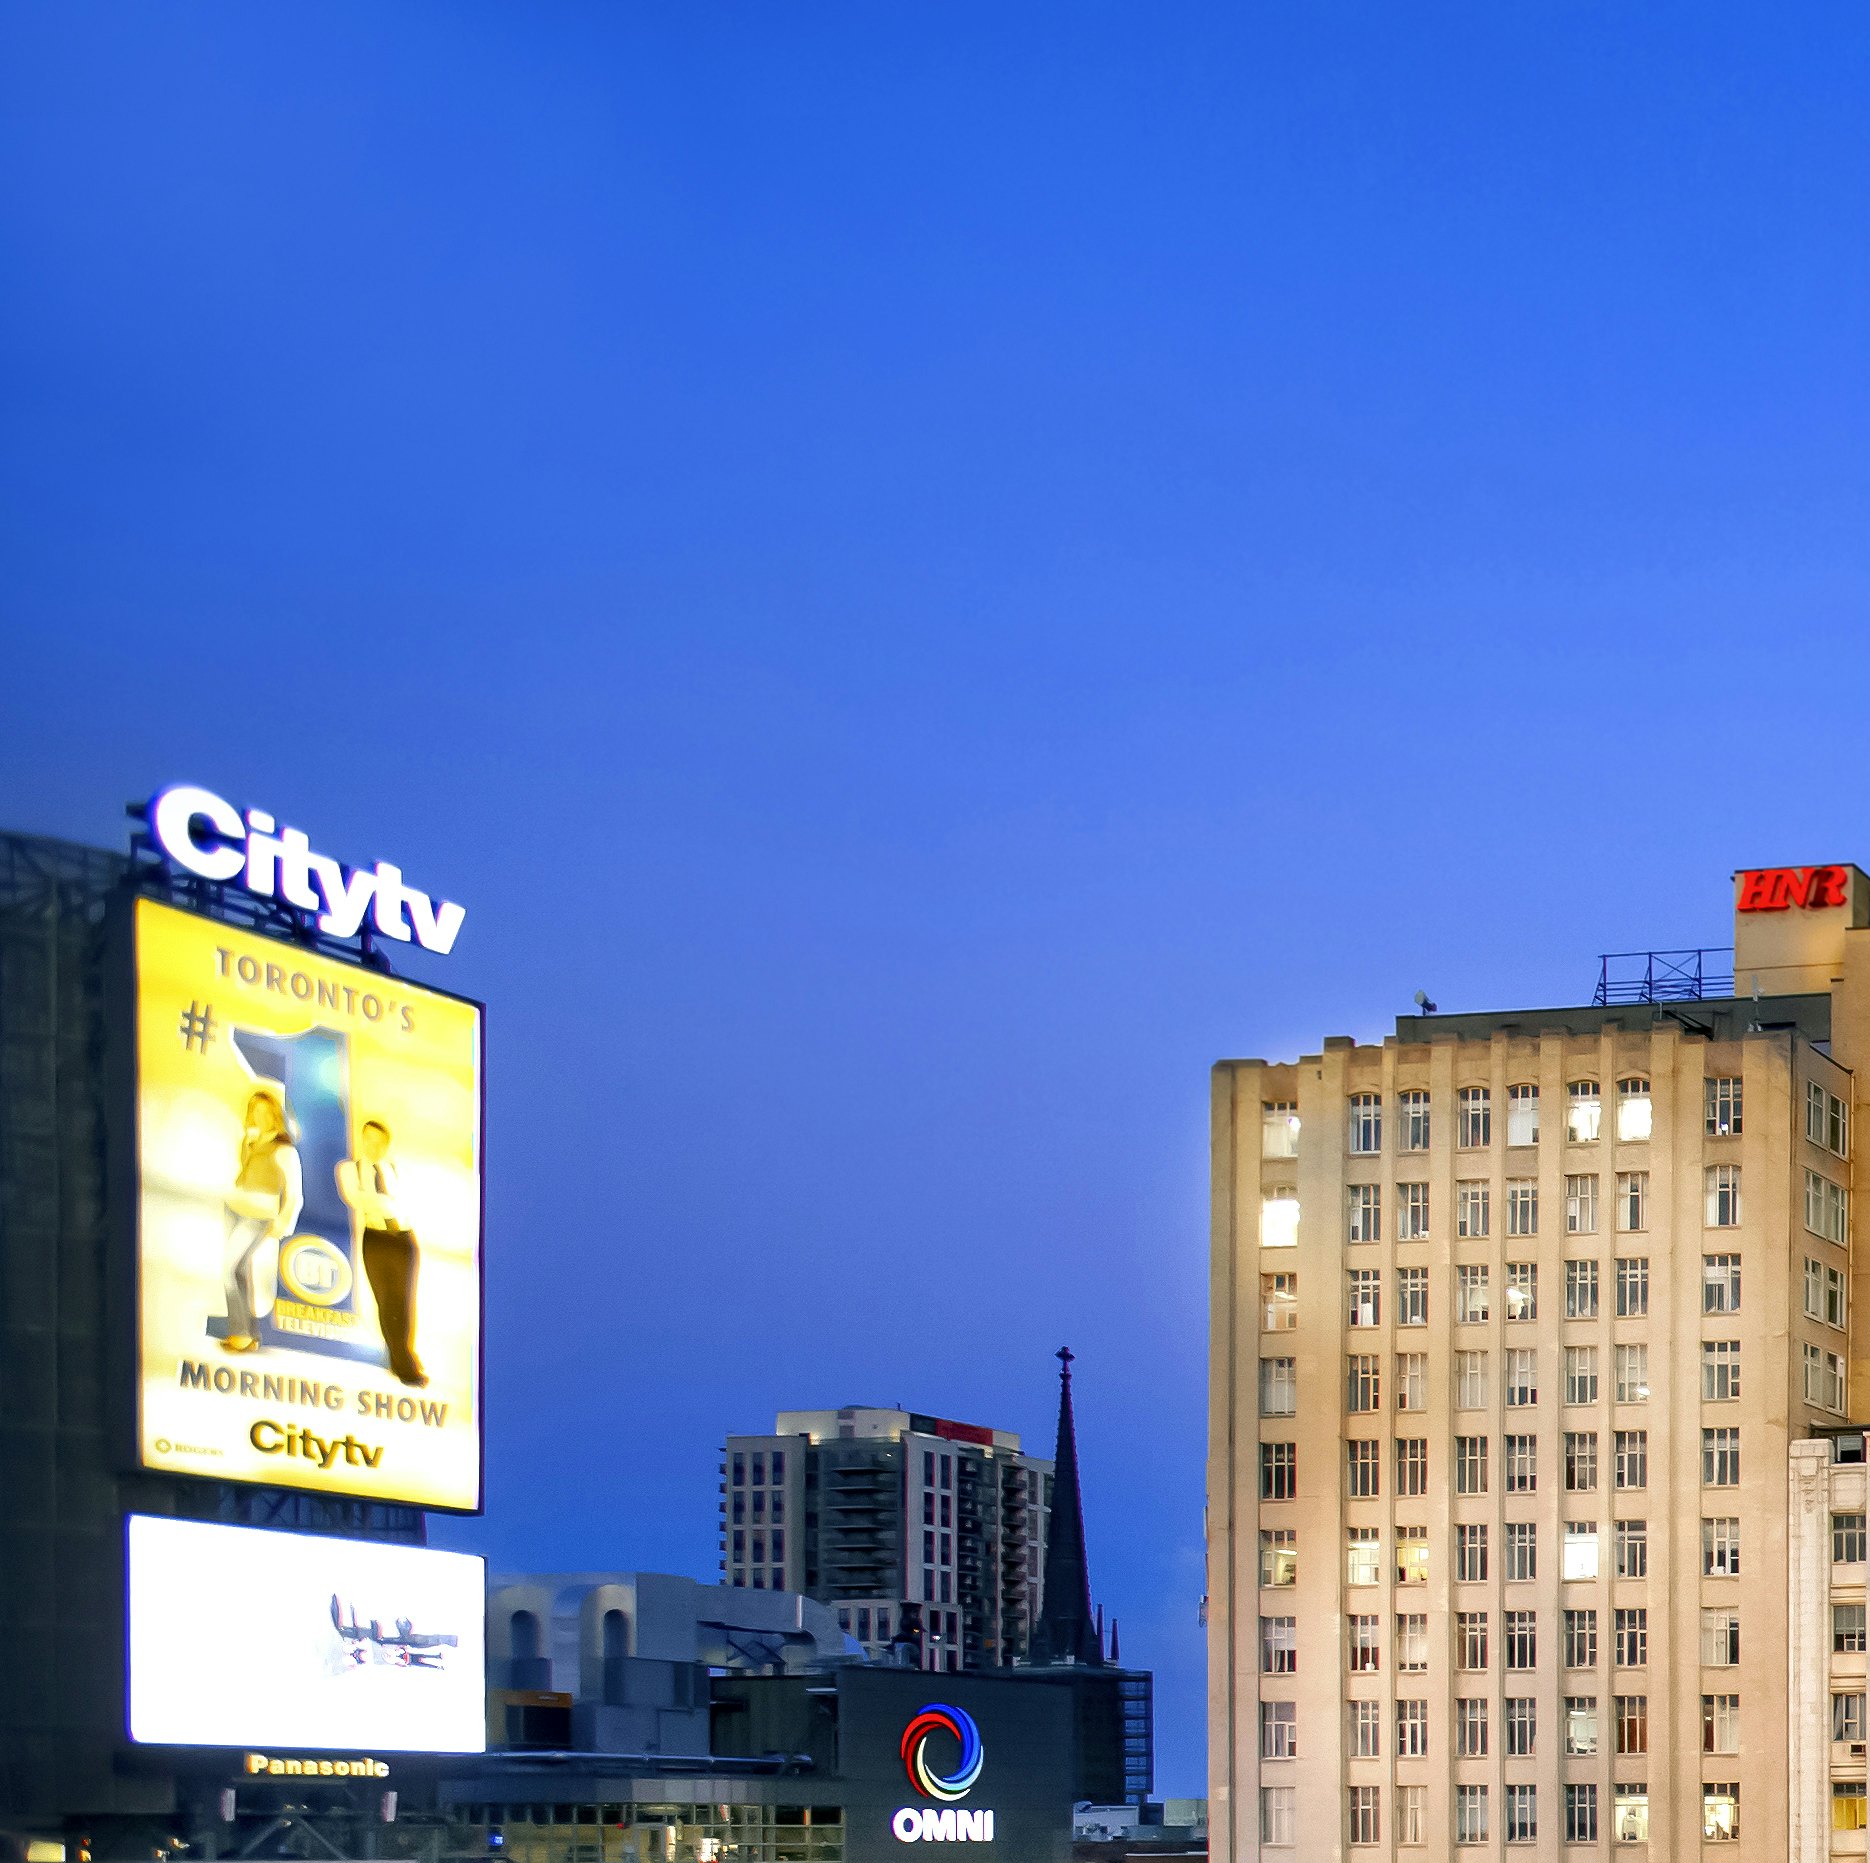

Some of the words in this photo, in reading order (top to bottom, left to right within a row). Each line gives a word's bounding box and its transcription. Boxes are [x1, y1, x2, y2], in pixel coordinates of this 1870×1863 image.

[156, 785, 466, 955] Citytv
[1736, 866, 1848, 912] HNR
[216, 945, 416, 1034] TORONTO'S
[180, 1360, 344, 1412] MORNING
[357, 1390, 448, 1429] SHOW
[249, 1420, 384, 1469] Citytv
[246, 1753, 390, 1778] Panasonic
[891, 1807, 994, 1843] OMNI
